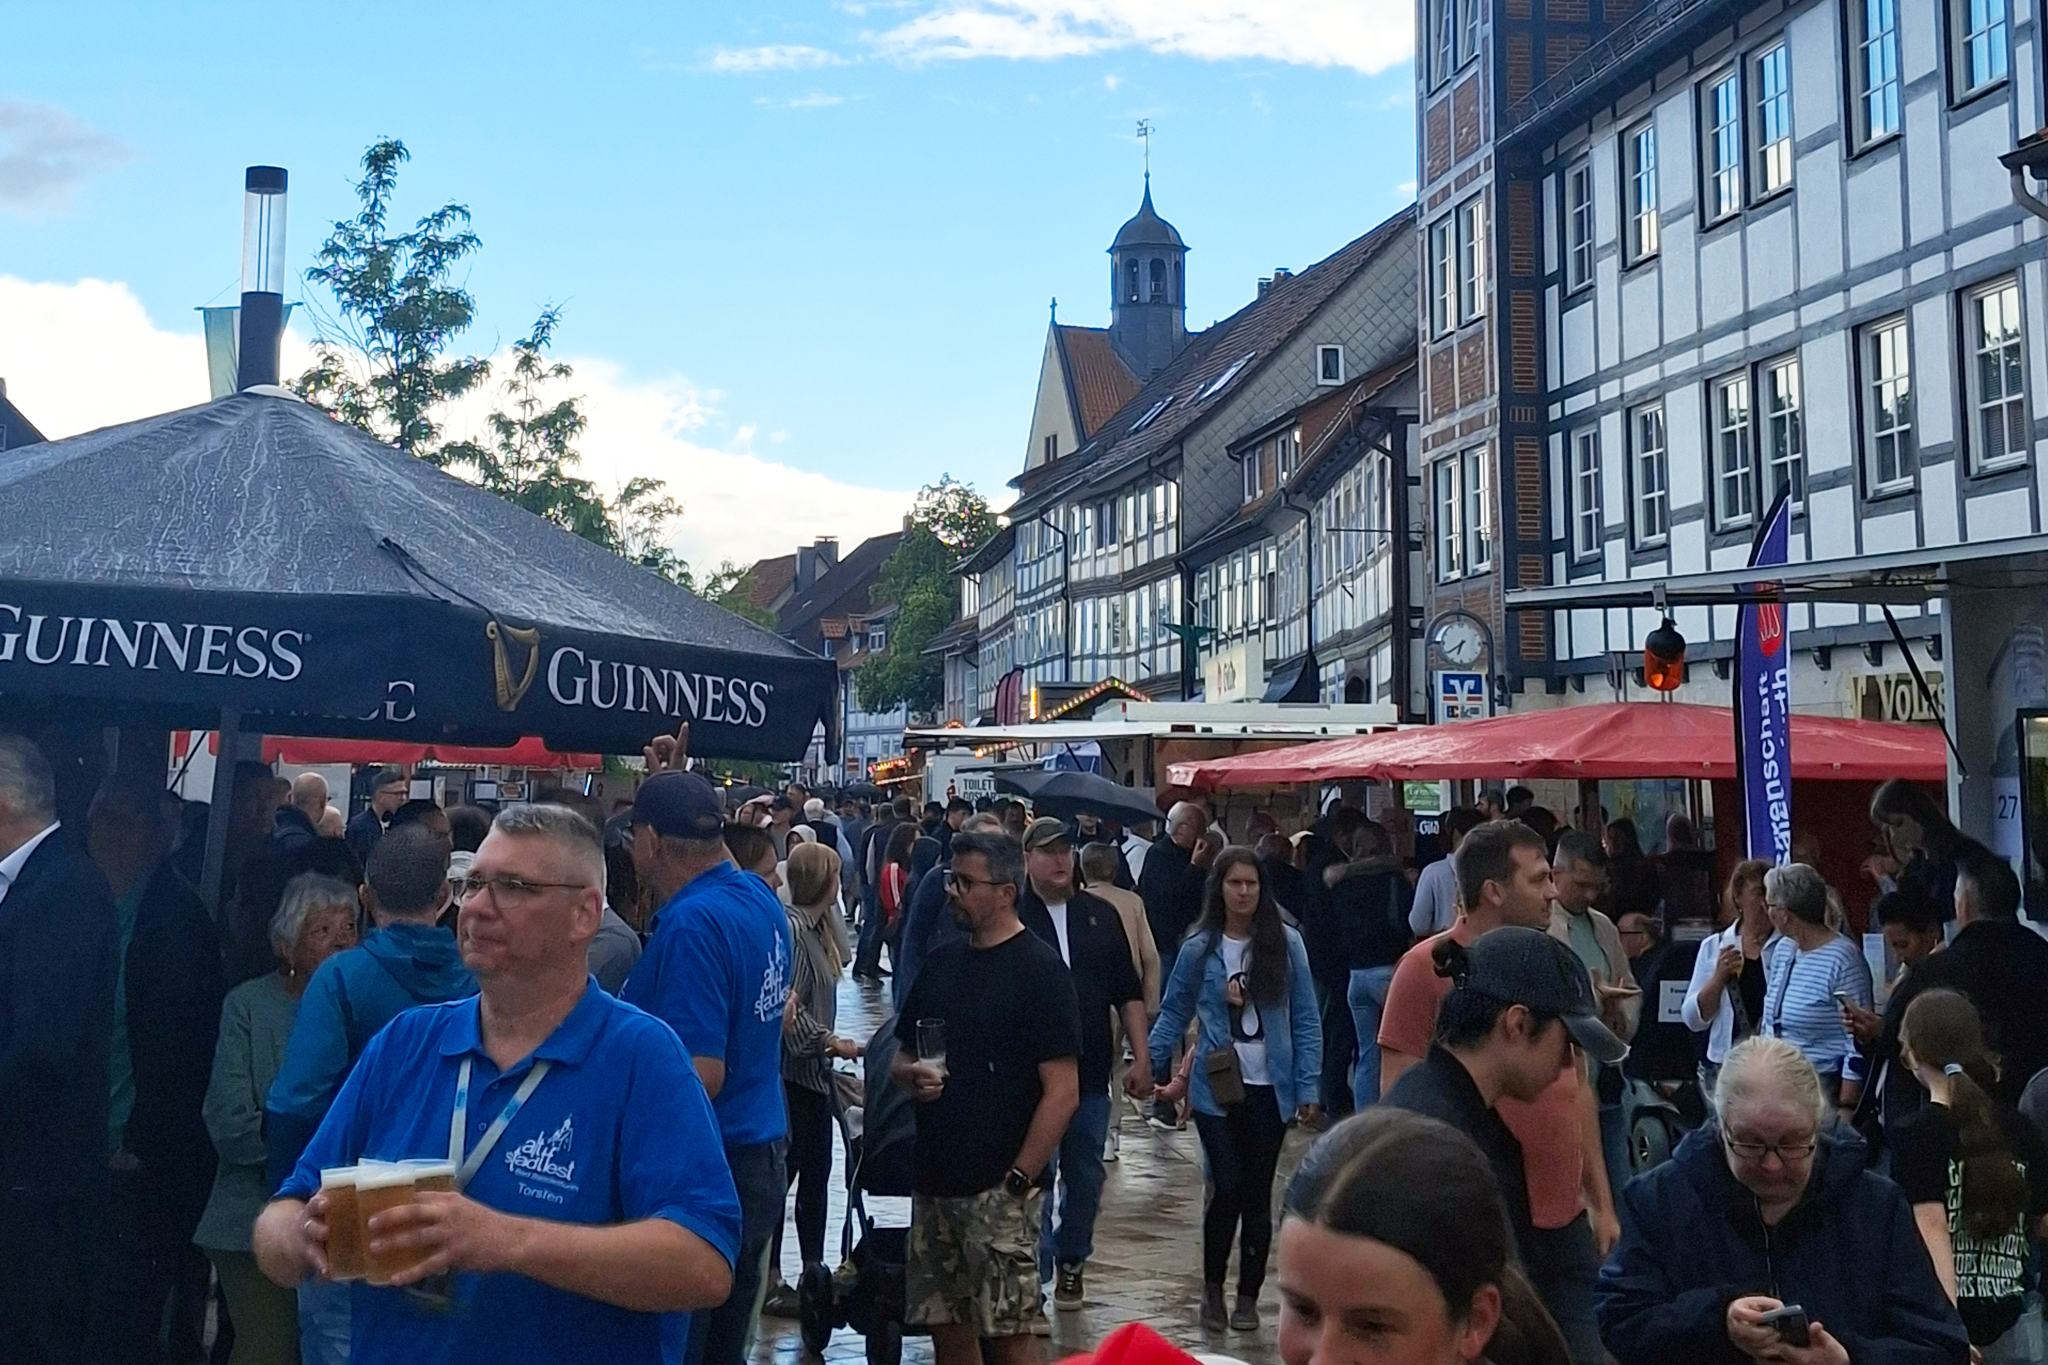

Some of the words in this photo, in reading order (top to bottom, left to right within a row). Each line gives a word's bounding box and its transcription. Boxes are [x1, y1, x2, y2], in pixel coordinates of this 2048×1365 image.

[547, 646, 770, 727] GUINNESS
[1998, 795, 2018, 819] 27
[518, 1182, 564, 1205] Torsten
